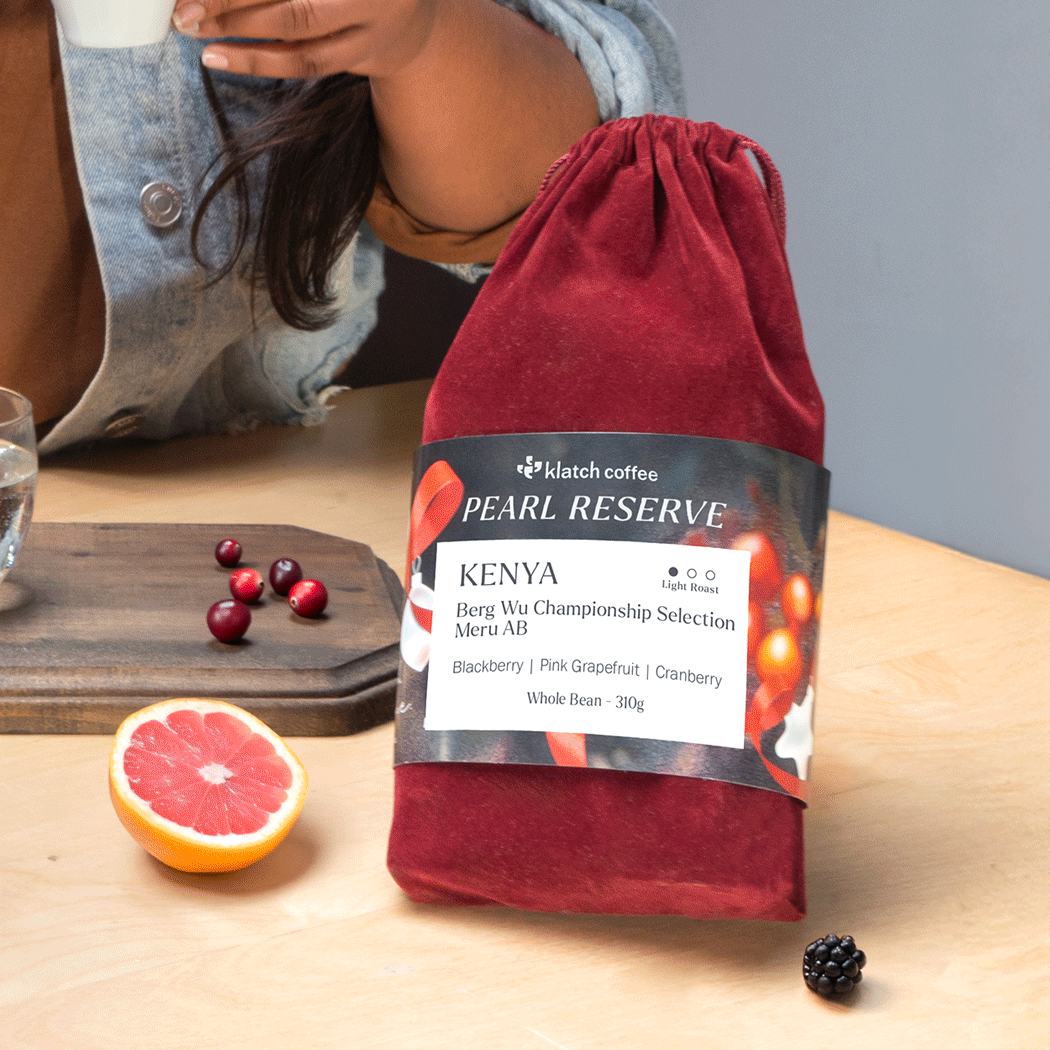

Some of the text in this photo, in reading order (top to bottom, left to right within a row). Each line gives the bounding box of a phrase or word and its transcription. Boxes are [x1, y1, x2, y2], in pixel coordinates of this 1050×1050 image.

[545, 461, 658, 482] klatch coffee
[461, 495, 727, 529] PEARL RESERVE
[460, 562, 558, 587] KENYA
[662, 580, 719, 594] Light Roast
[456, 600, 736, 631] Berg Wu Championship Selection
[455, 620, 528, 638] Meru AB
[452, 660, 524, 675] Blackberry
[540, 658, 568, 672] Pink
[571, 659, 640, 677] Grapefruit
[655, 665, 722, 689] Cranberry
[527, 691, 566, 705] Whole
[570, 693, 602, 707] Bean
[615, 695, 645, 712] 310g
